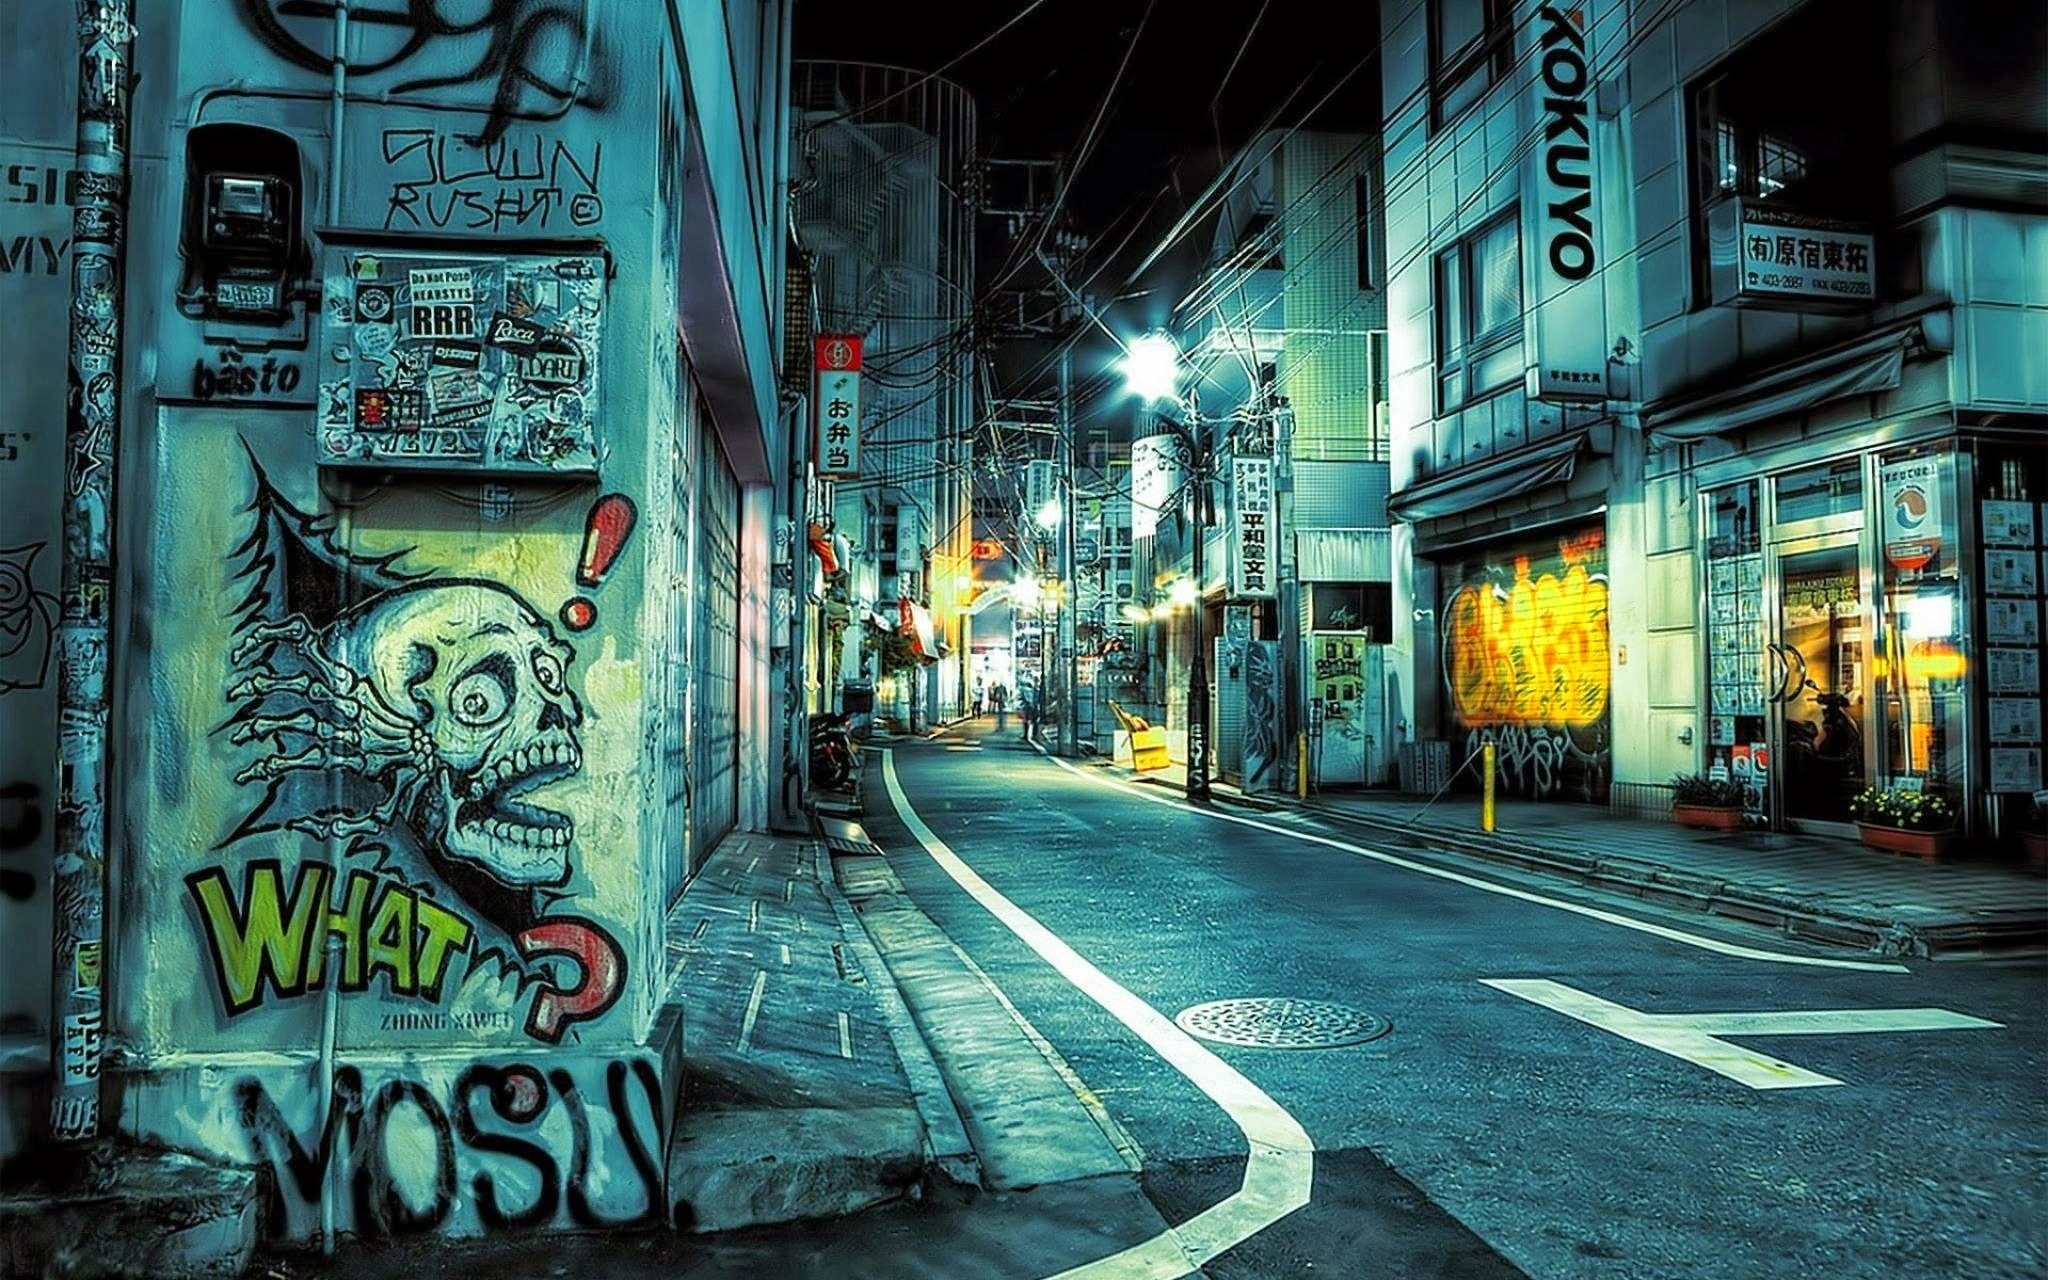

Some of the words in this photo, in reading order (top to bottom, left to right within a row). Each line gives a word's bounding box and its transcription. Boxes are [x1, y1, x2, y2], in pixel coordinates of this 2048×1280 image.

[1541, 6, 1595, 281] KOKUYO
[413, 305, 474, 335] RRR
[827, 397, 853, 469] お弁当
[1242, 513, 1266, 591] 平和堂文具
[183, 858, 473, 1016] WHAT
